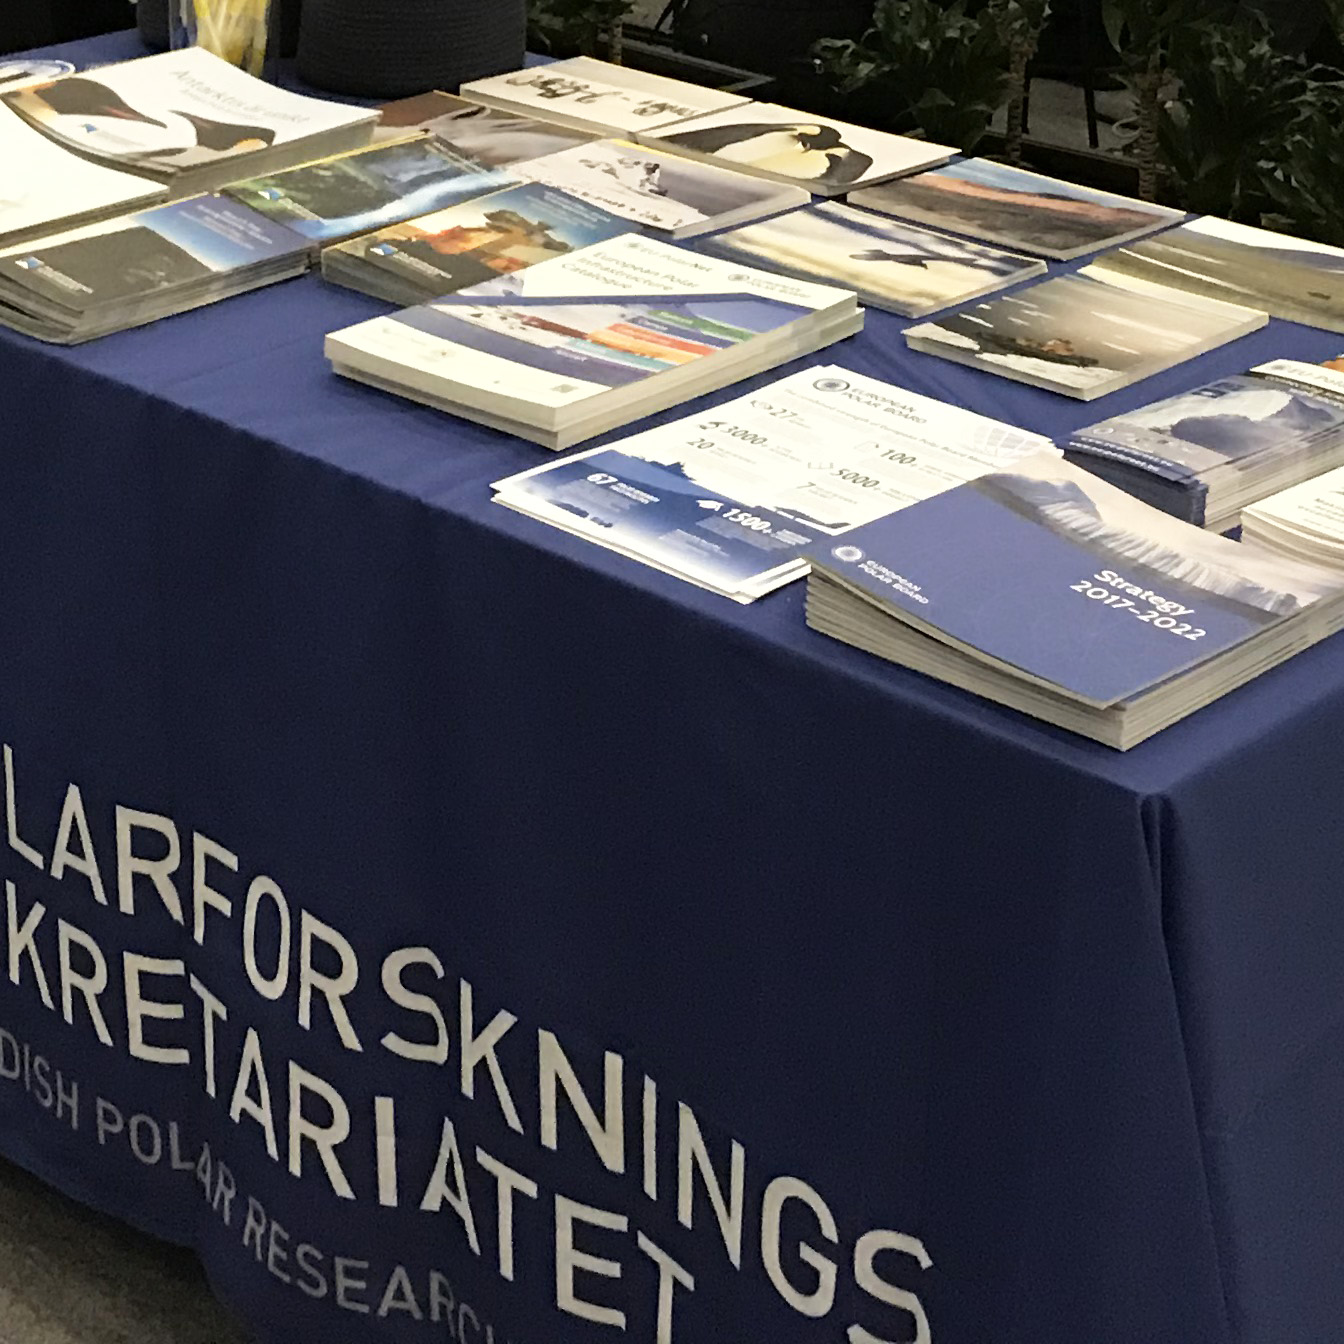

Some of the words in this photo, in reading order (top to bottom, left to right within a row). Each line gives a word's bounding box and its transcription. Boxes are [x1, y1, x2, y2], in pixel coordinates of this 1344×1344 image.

[577, 257, 674, 291] Infrastructure
[593, 252, 659, 277] European
[769, 408, 798, 420] 27
[841, 392, 878, 408] POLAR
[882, 407, 927, 425] BOARD
[852, 388, 918, 413] EUROPEAN
[687, 437, 715, 450] 20
[586, 473, 619, 485] 67
[858, 563, 892, 584] POLAR
[892, 582, 929, 604] BOARD
[866, 559, 922, 592] EUROPEAN
[1093, 569, 1195, 616] Strategy
[97, 1097, 237, 1225] POLAR
